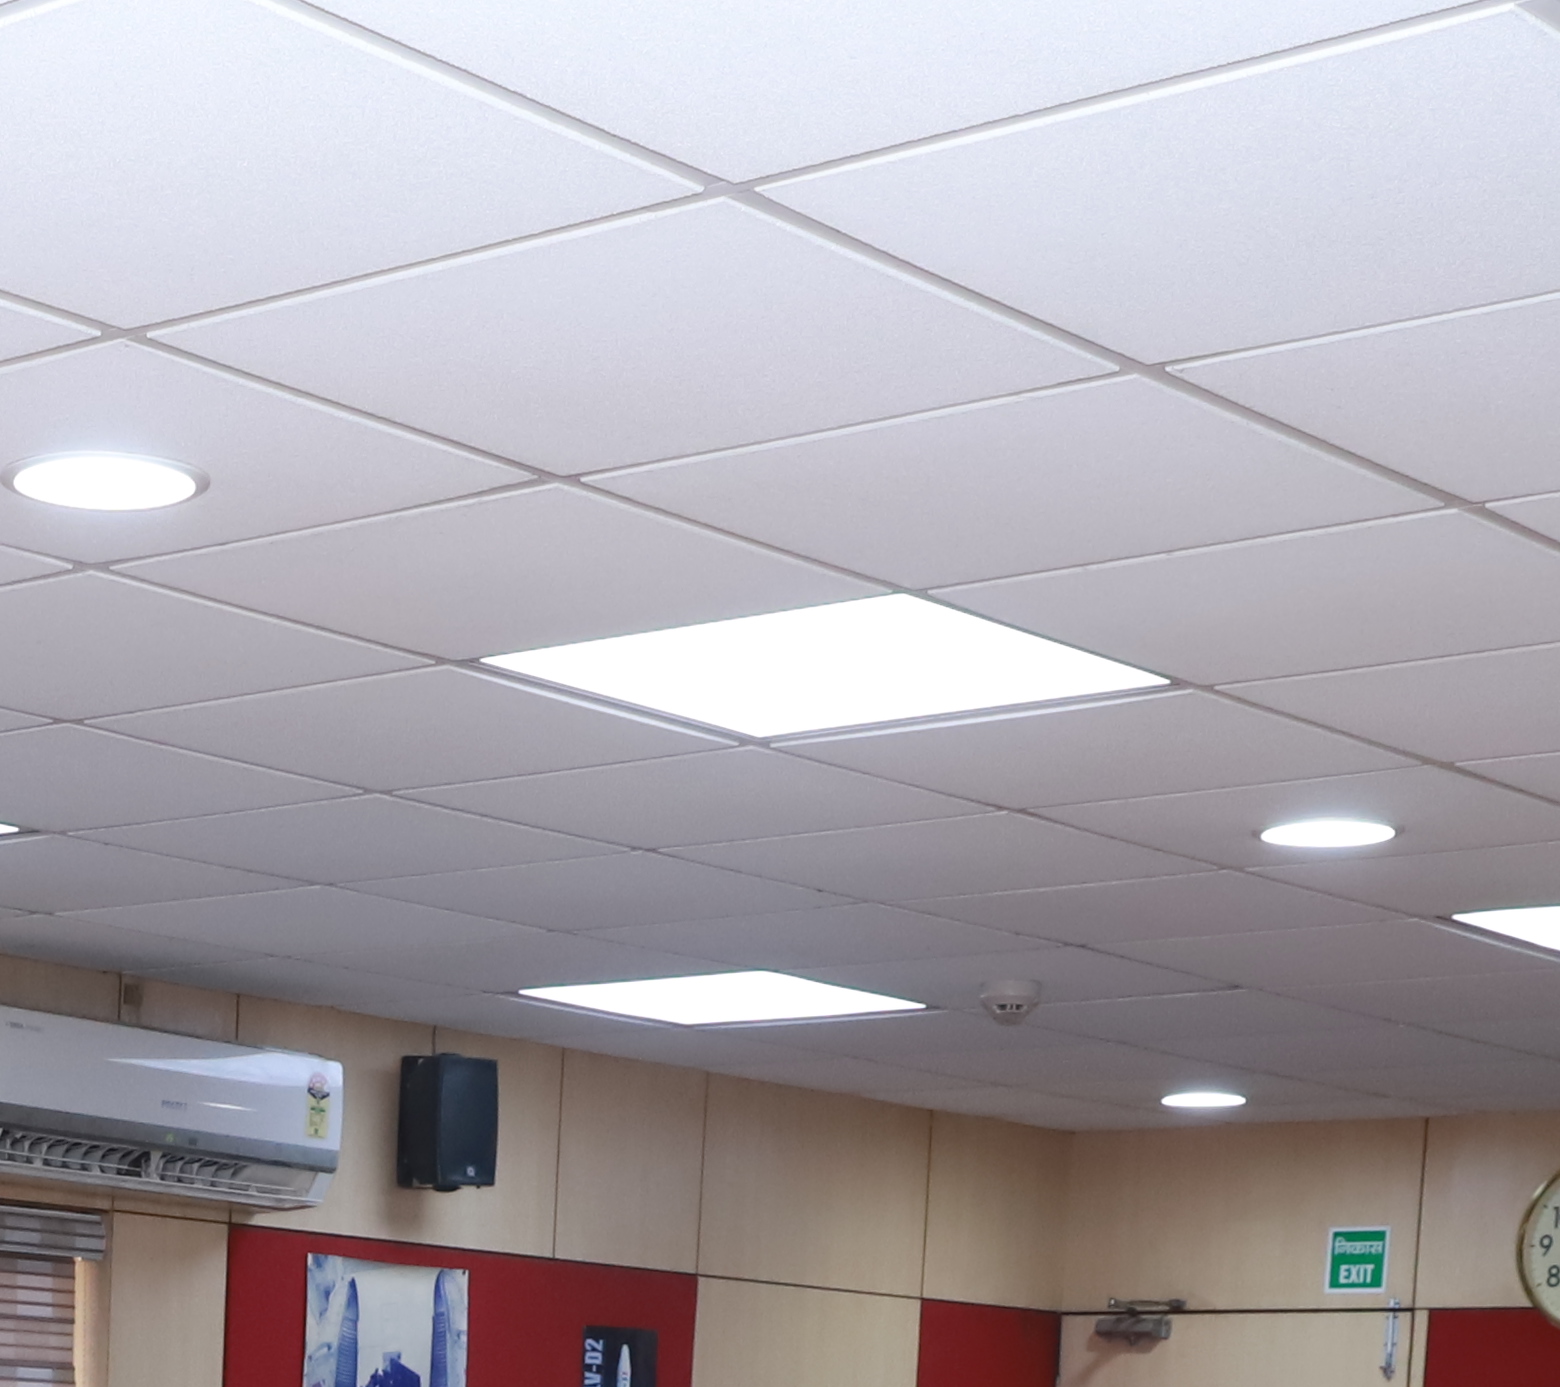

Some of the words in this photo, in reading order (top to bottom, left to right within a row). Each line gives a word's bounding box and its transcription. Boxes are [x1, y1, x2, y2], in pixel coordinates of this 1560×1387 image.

[1335, 1237, 1383, 1255] निकास
[1539, 1234, 1553, 1257] 9
[1339, 1264, 1375, 1283] EXIT
[1547, 1265, 1560, 1288] 8
